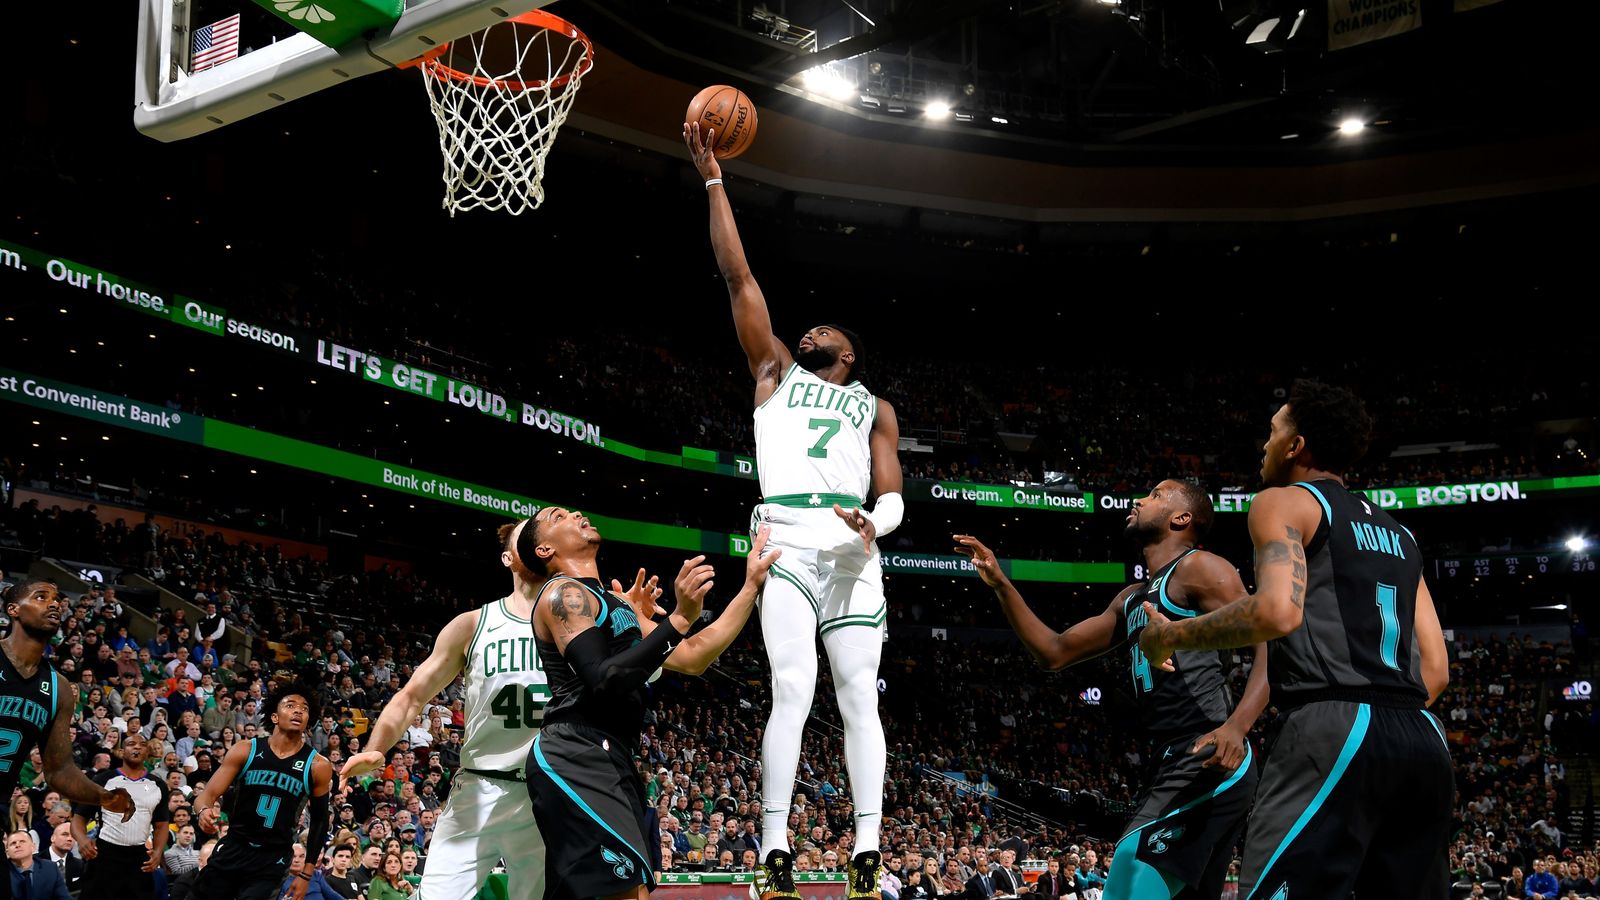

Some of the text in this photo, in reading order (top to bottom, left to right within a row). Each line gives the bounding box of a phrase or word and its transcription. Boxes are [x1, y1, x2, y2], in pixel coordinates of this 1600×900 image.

[1333, 0, 1416, 34] CHAMPIONS
[720, 104, 748, 153] SPALDING
[47, 260, 91, 290] Our
[97, 273, 170, 314] house.
[185, 302, 224, 330] Our
[227, 318, 300, 353] season.
[317, 339, 382, 380] LET'S
[392, 364, 437, 396] GET
[448, 380, 512, 422] LOUD,
[522, 403, 605, 448] BOSTON.
[23, 380, 126, 418] Convenient
[787, 382, 869, 429] CELTICS
[808, 418, 841, 458] 7
[736, 460, 752, 473] TD
[383, 467, 419, 490] Bank
[421, 480, 436, 494] of
[439, 483, 460, 499] the
[463, 487, 509, 511] Boston
[931, 484, 959, 500] Our
[961, 487, 1003, 502] team.
[1013, 490, 1040, 505] Our
[1044, 494, 1089, 509] house.
[1100, 495, 1130, 509] Our
[1416, 481, 1527, 505] BOSTON.
[731, 538, 748, 552] TD
[1351, 521, 1406, 560] MONK
[892, 556, 957, 570] Convenient
[1449, 568, 1456, 577] 9
[1475, 566, 1490, 576] 12
[1508, 565, 1516, 575] 2
[1539, 564, 1547, 573] 0
[1474, 559, 1490, 567] AST
[1536, 556, 1549, 564] TO
[1376, 581, 1402, 671] 1
[1086, 687, 1101, 701] 10
[1572, 681, 1592, 696] 10
[22, 698, 48, 731] CITY
[491, 683, 553, 728] 46
[245, 770, 304, 797] BUZZ CITY
[256, 794, 281, 829] 4
